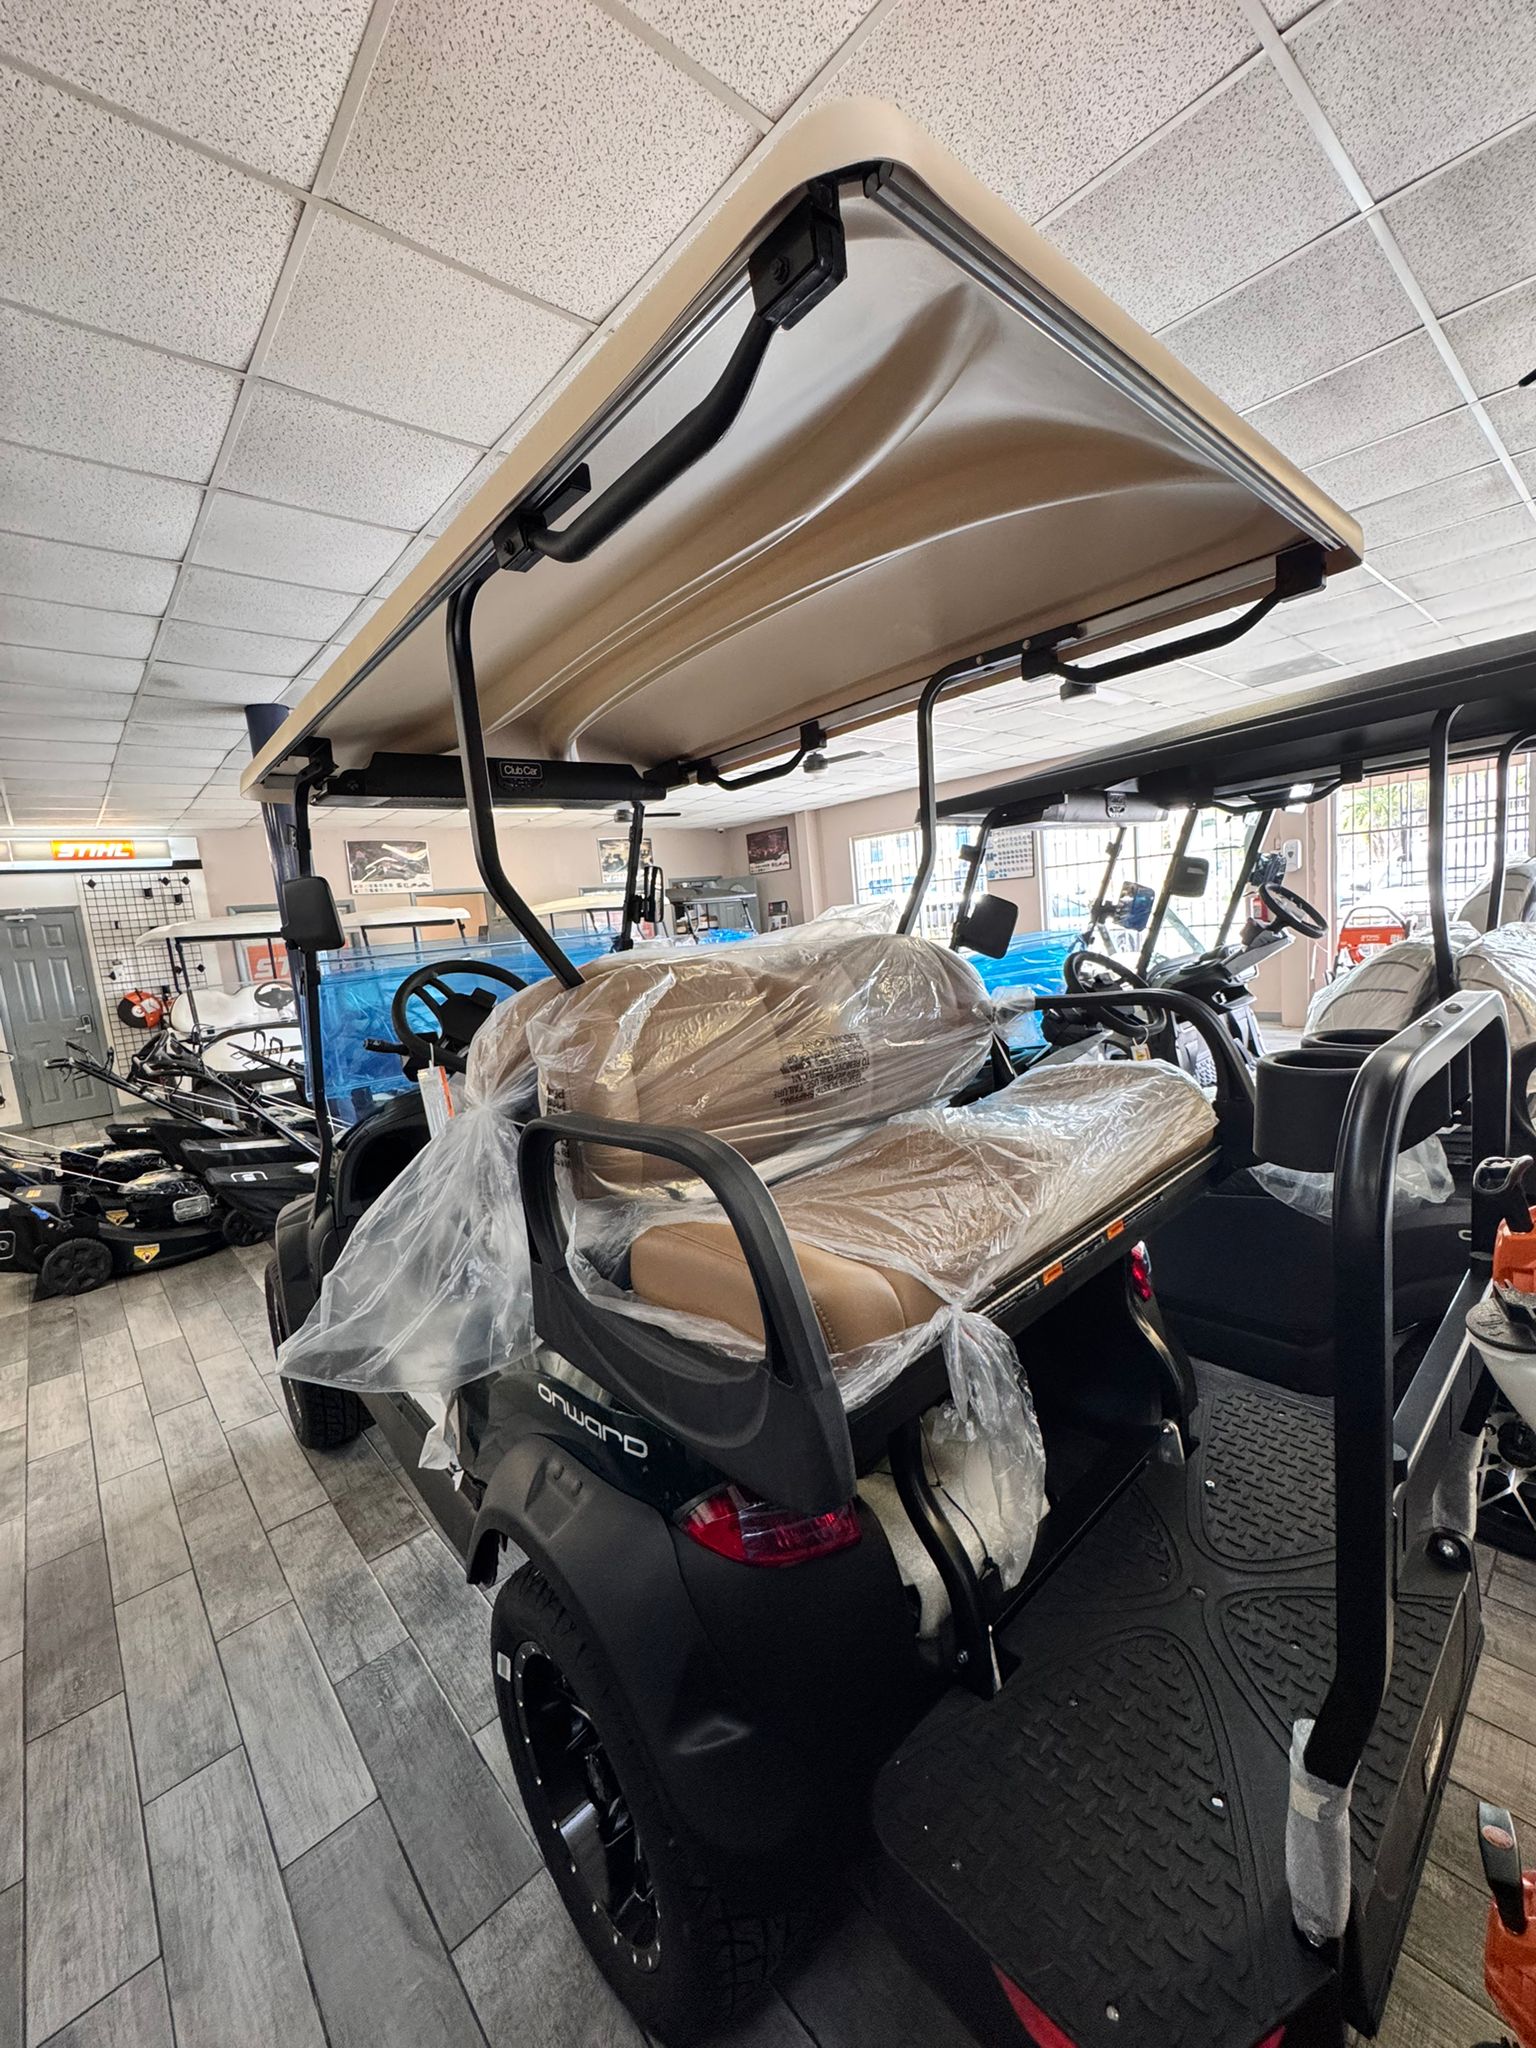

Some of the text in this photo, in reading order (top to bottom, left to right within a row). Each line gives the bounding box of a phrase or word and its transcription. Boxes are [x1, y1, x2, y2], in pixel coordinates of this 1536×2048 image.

[504, 765, 538, 776] Club Car
[58, 843, 130, 858] STIHL
